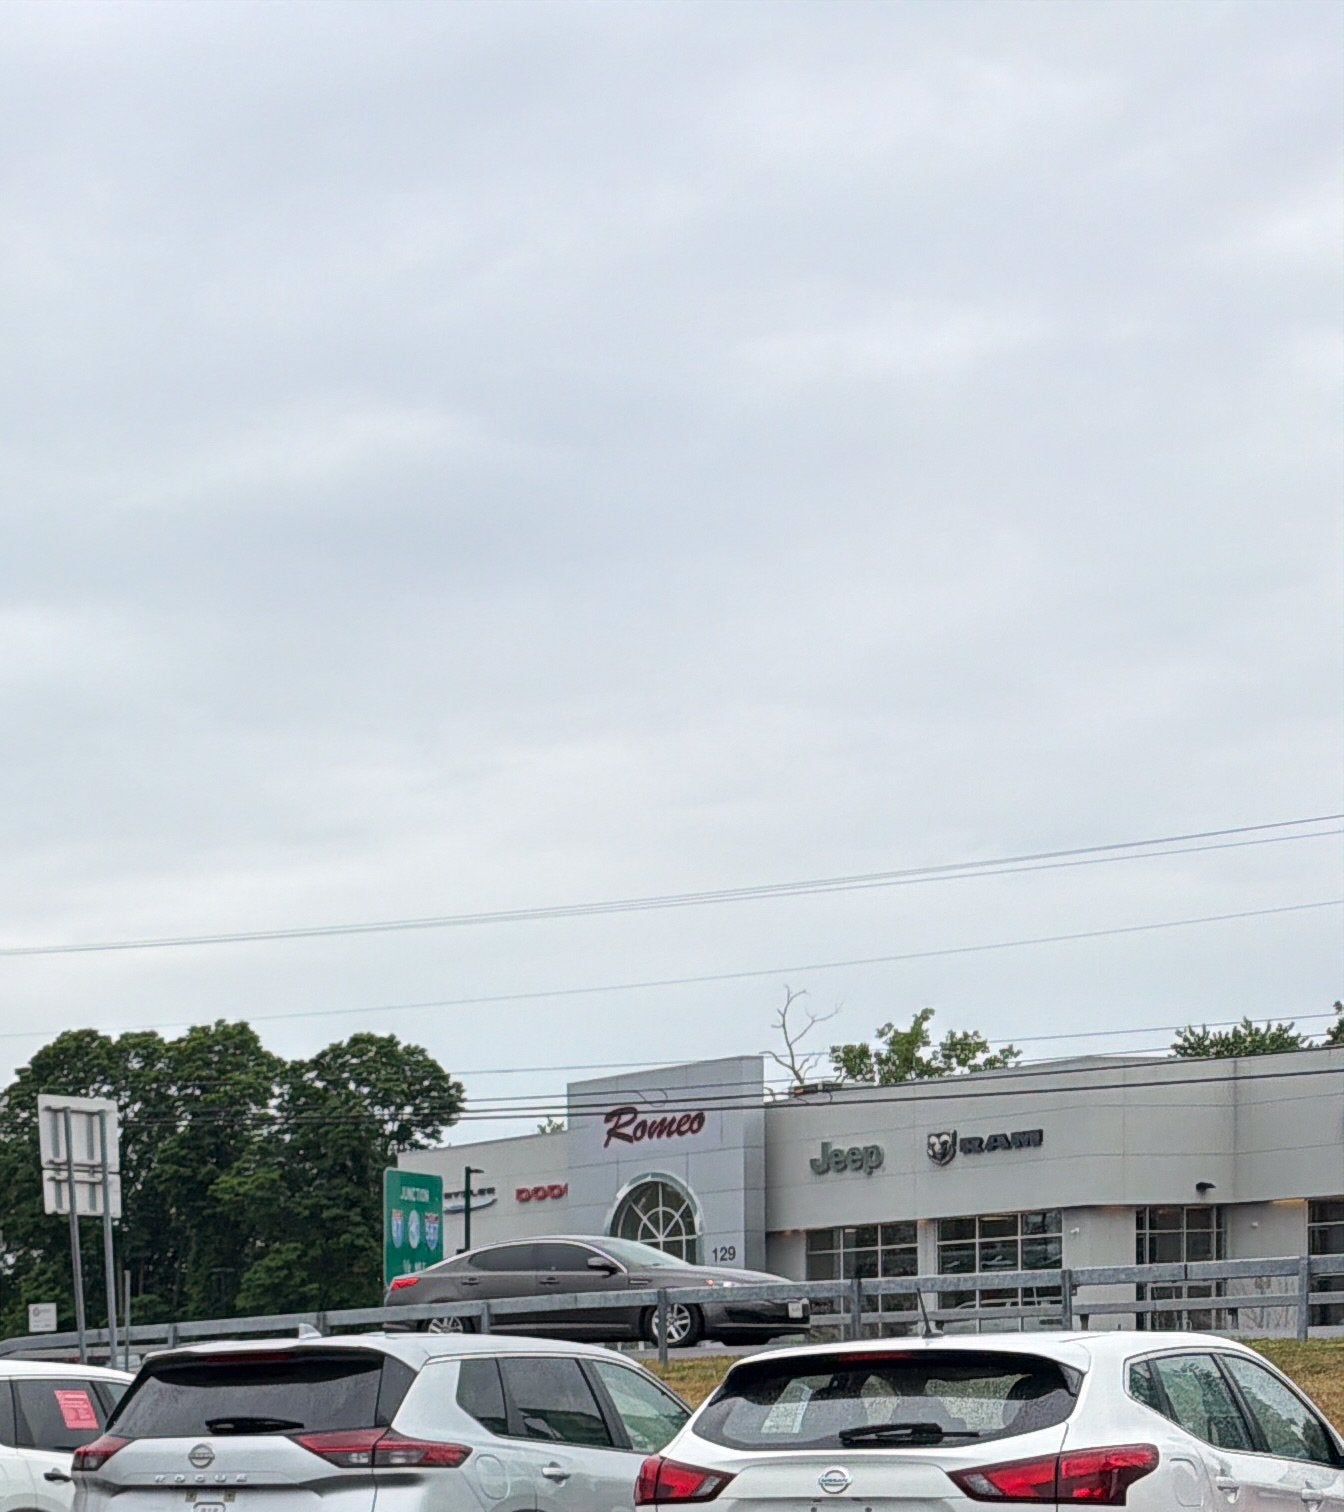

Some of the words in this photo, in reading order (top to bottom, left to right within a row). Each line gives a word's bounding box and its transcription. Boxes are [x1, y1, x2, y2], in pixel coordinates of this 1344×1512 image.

[604, 1106, 705, 1148] Romeo
[960, 1129, 1043, 1155] RAM
[810, 1142, 884, 1175] Jeep
[515, 1183, 569, 1202] DOD
[712, 1246, 736, 1262] 129
